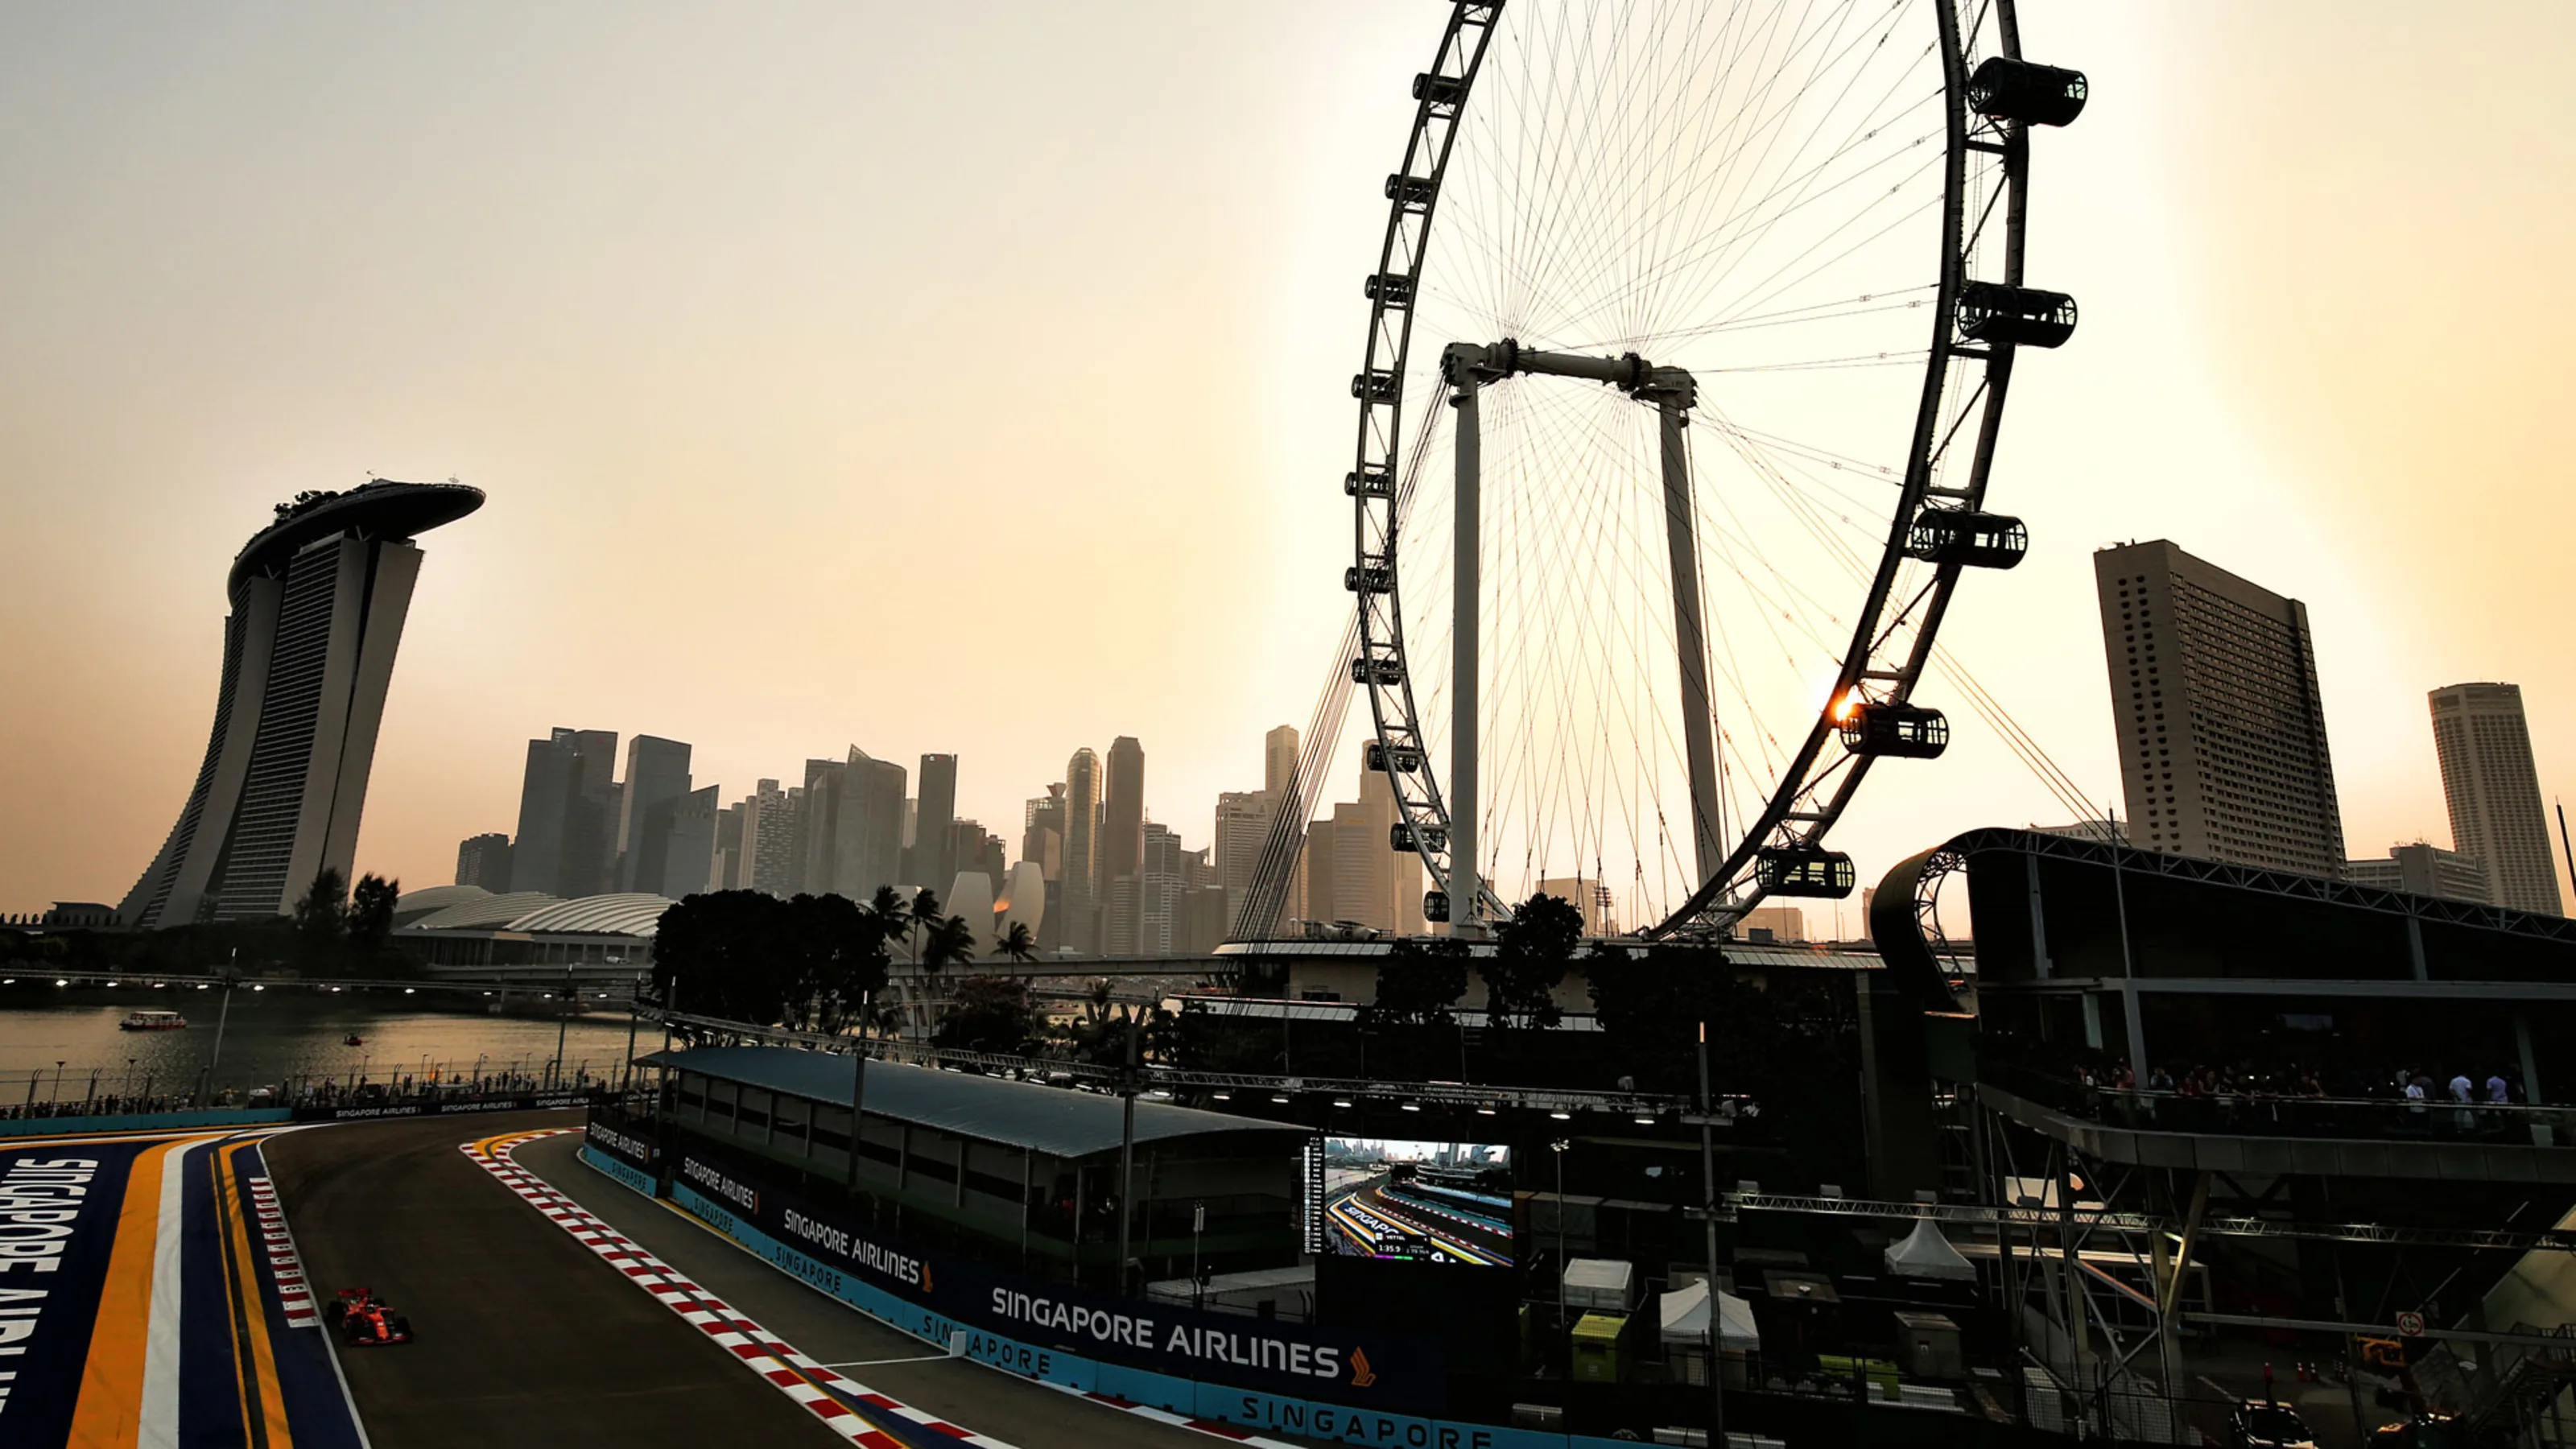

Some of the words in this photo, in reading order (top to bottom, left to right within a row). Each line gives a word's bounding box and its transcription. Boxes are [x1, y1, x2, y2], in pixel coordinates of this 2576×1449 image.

[336, 1108, 380, 1117] SINGAPORE
[382, 1106, 416, 1114] AIRLINES
[441, 1103, 481, 1112] SINGAPORE
[482, 1101, 513, 1109] AIRLINES
[590, 1121, 617, 1147] SINGAPORE
[617, 1134, 645, 1159] AIRLINES
[684, 1157, 720, 1191] SINGAPORE
[720, 1176, 753, 1209] AIRLINES
[775, 1246, 841, 1292] SINGAPORE
[784, 1208, 848, 1257] SINGAPORE
[852, 1238, 919, 1285] AIRLINES
[924, 1315, 1051, 1374] SINAPORE
[992, 1287, 1154, 1349] SINGAPORE
[1166, 1324, 1340, 1378] AIRLINES
[1242, 1397, 1492, 1449] SINGAPORE
